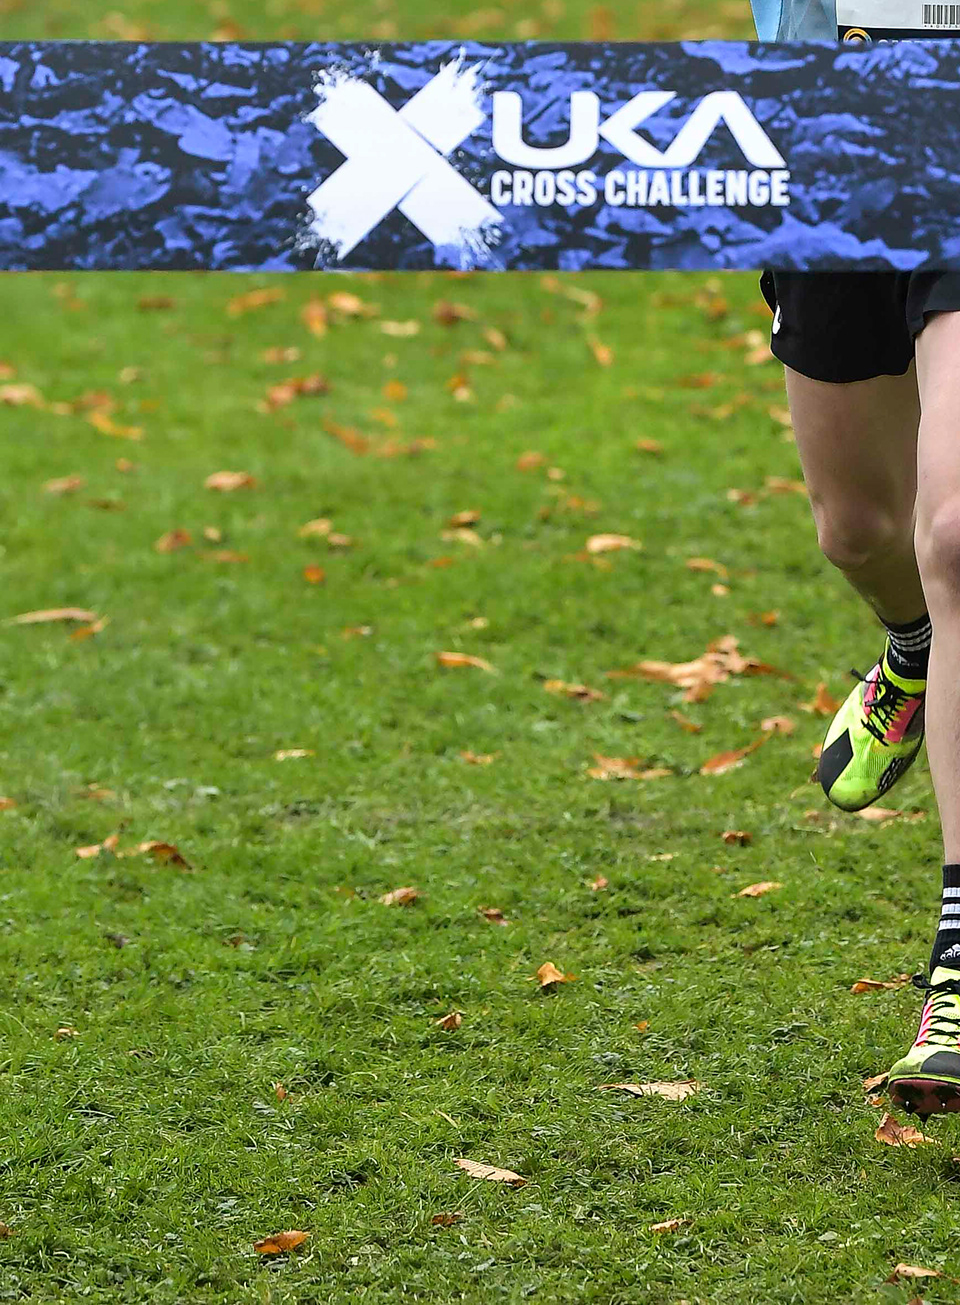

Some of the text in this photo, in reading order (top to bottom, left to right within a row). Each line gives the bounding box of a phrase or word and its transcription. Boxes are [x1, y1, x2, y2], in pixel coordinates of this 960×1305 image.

[491, 90, 788, 170] UKA
[490, 169, 791, 207] CROSS CHALLENGE
